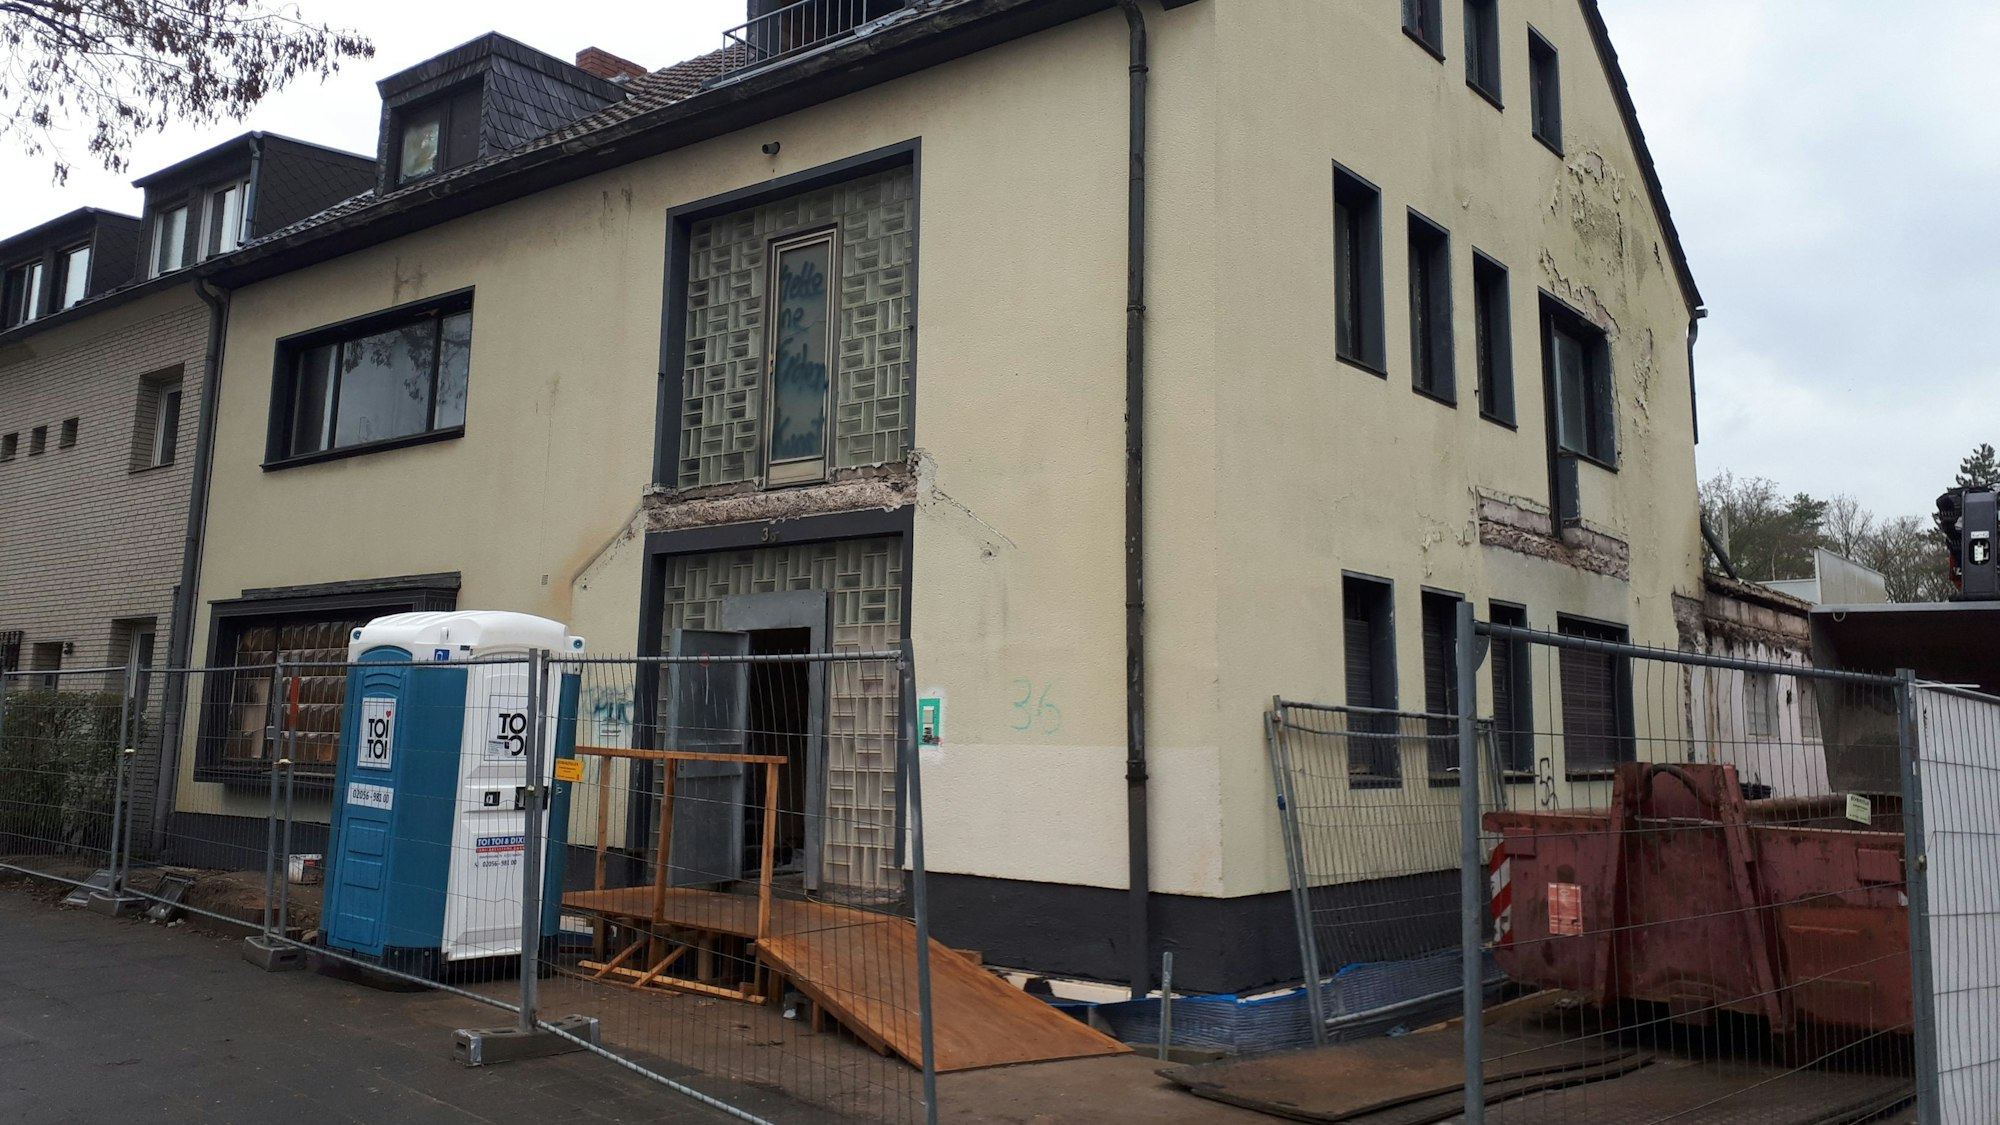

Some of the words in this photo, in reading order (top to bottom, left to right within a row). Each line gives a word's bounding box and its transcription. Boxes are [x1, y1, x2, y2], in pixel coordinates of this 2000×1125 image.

[1011, 677, 1062, 735] 36
[368, 718, 390, 739] TOI
[499, 713, 527, 734] TO
[367, 739, 388, 759] TOI
[478, 838, 490, 846] TOI
